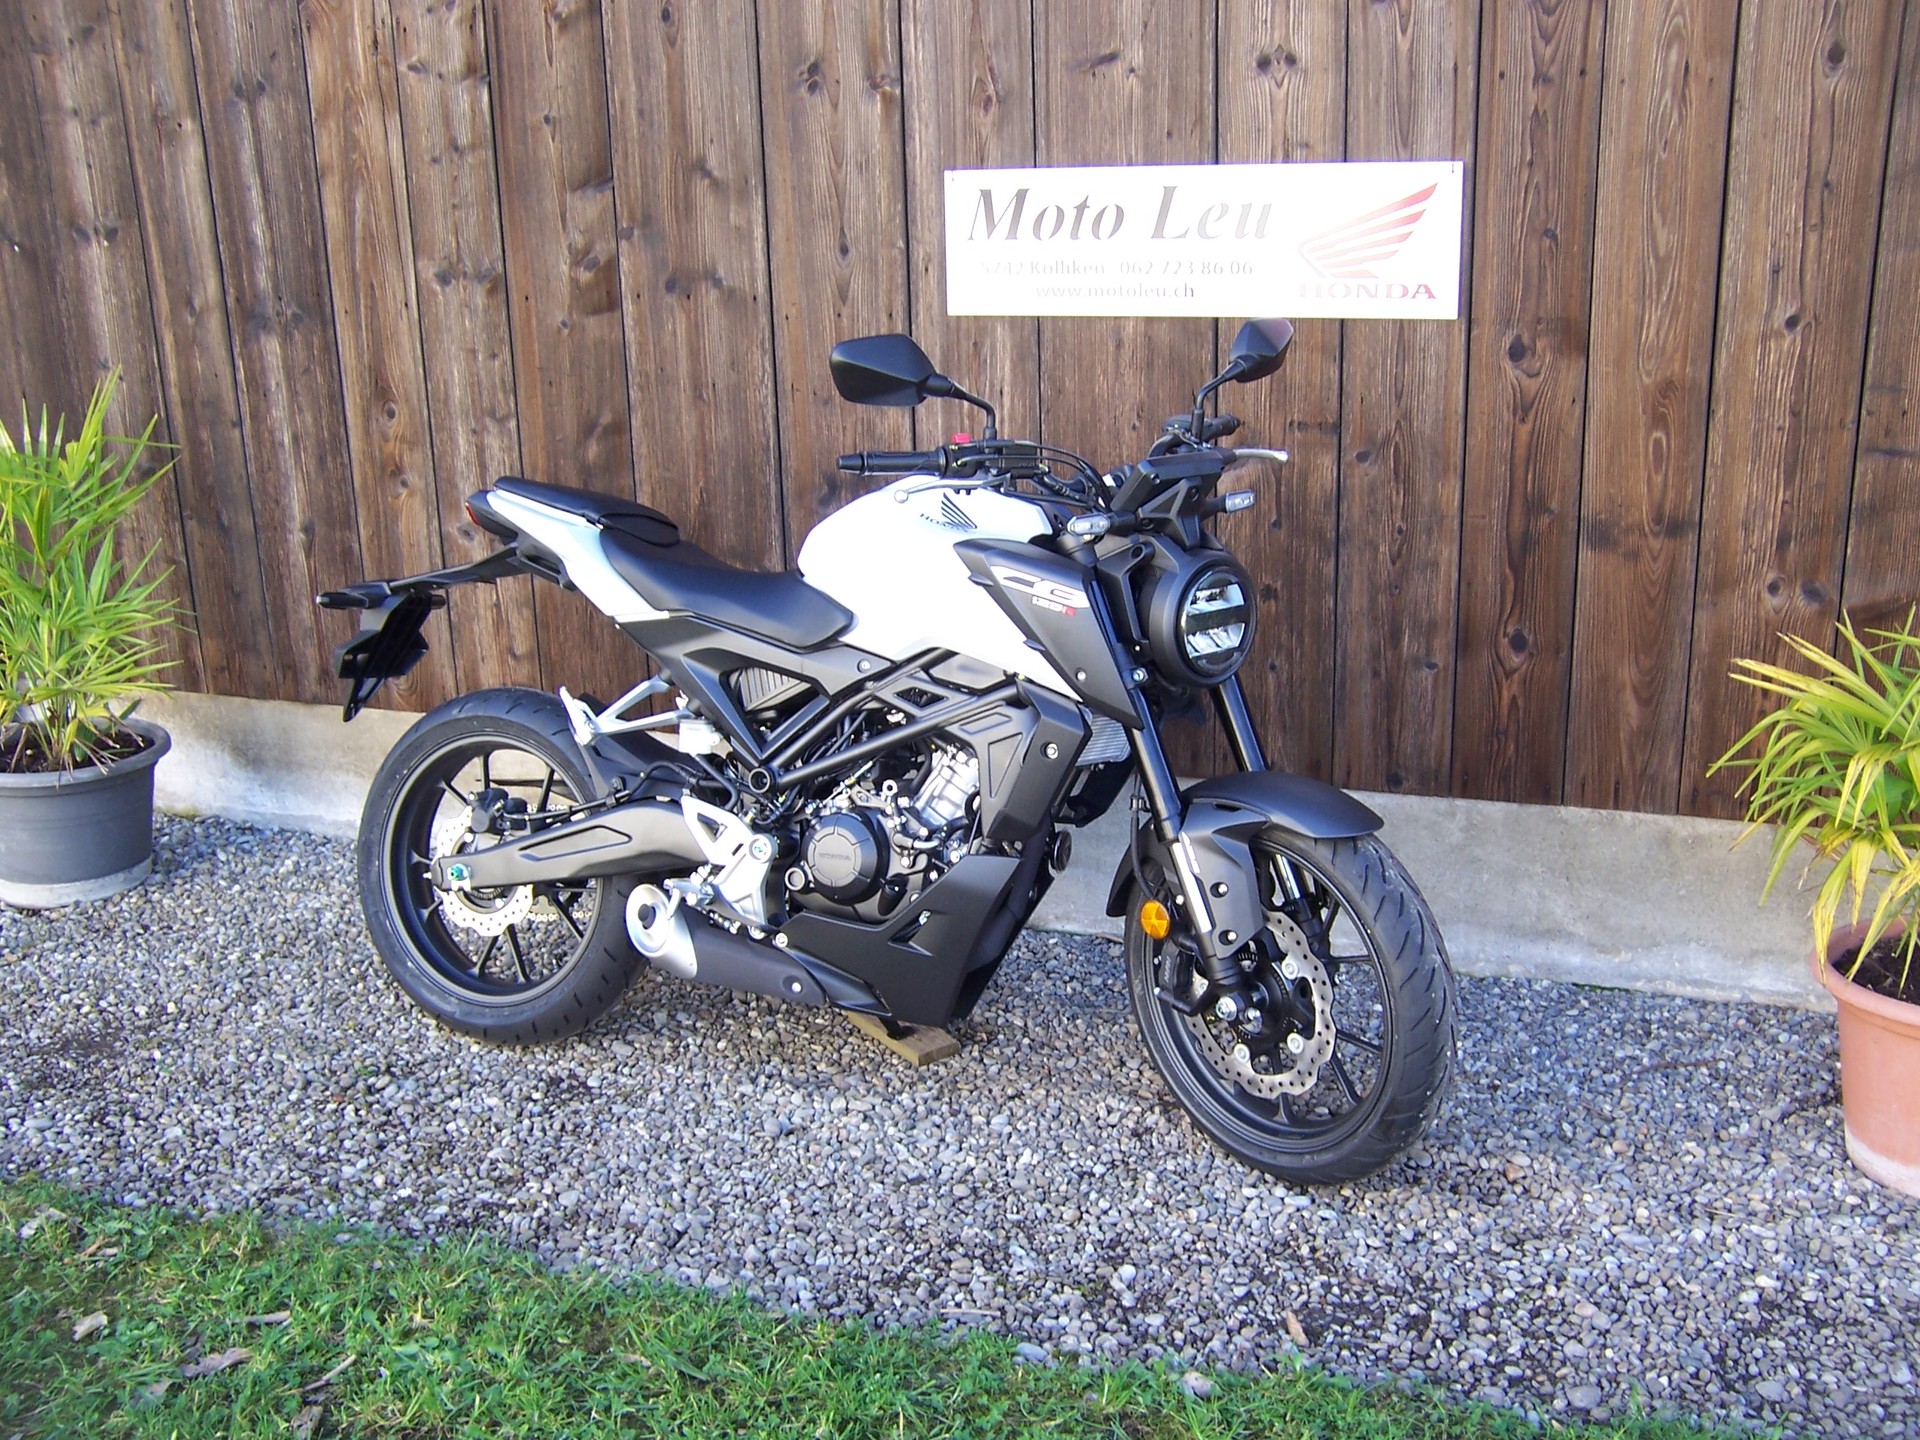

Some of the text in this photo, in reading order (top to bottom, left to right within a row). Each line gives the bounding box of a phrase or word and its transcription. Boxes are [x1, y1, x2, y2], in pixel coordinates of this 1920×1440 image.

[967, 185, 1273, 241] Moto Leu
[1120, 260, 1154, 275] 062
[1201, 261, 1224, 275] 86
[1230, 260, 1253, 275] 06
[1036, 282, 1195, 298] www.motoleu.ch
[1299, 282, 1437, 300] HONDA
